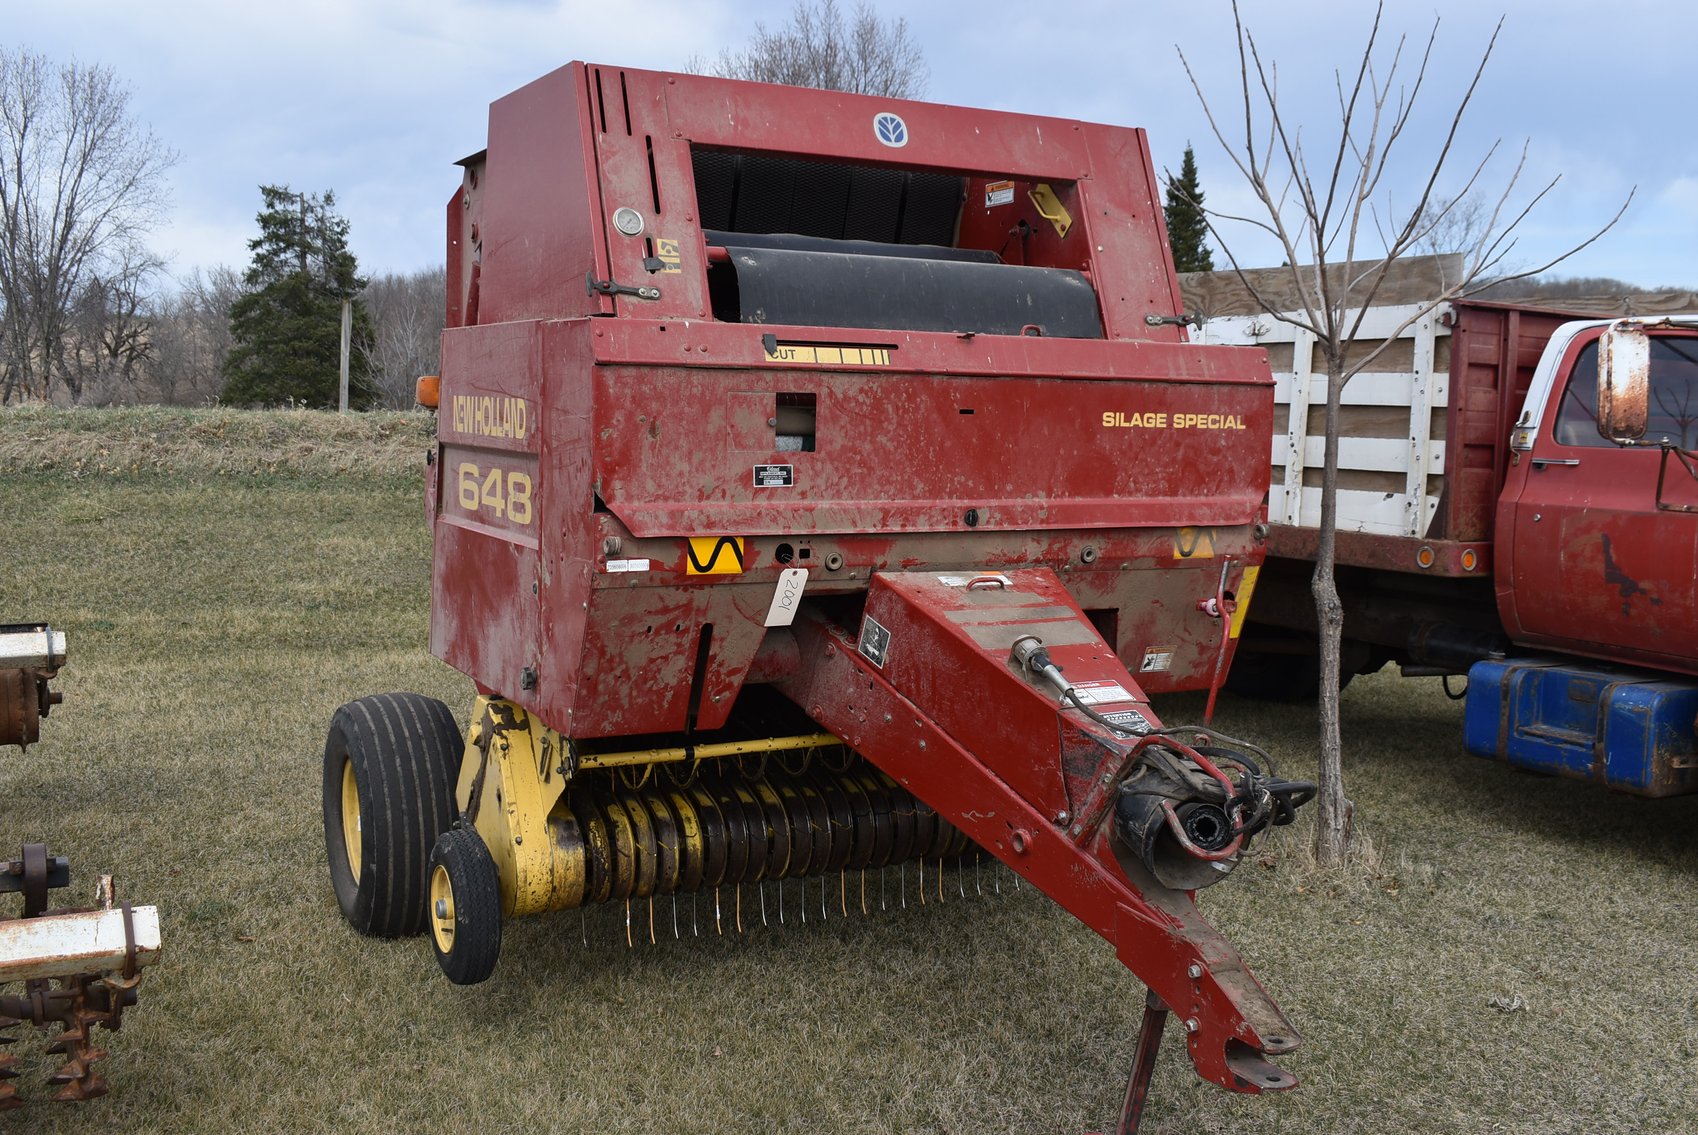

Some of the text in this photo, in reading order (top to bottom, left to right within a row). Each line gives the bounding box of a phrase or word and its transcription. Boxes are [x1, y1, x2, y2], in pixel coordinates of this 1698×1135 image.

[453, 395, 526, 439] NEW HOLLAND
[1102, 412, 1246, 429] SILAGE SPECIAL
[459, 463, 532, 525] 648
[778, 579, 799, 611] 2001
